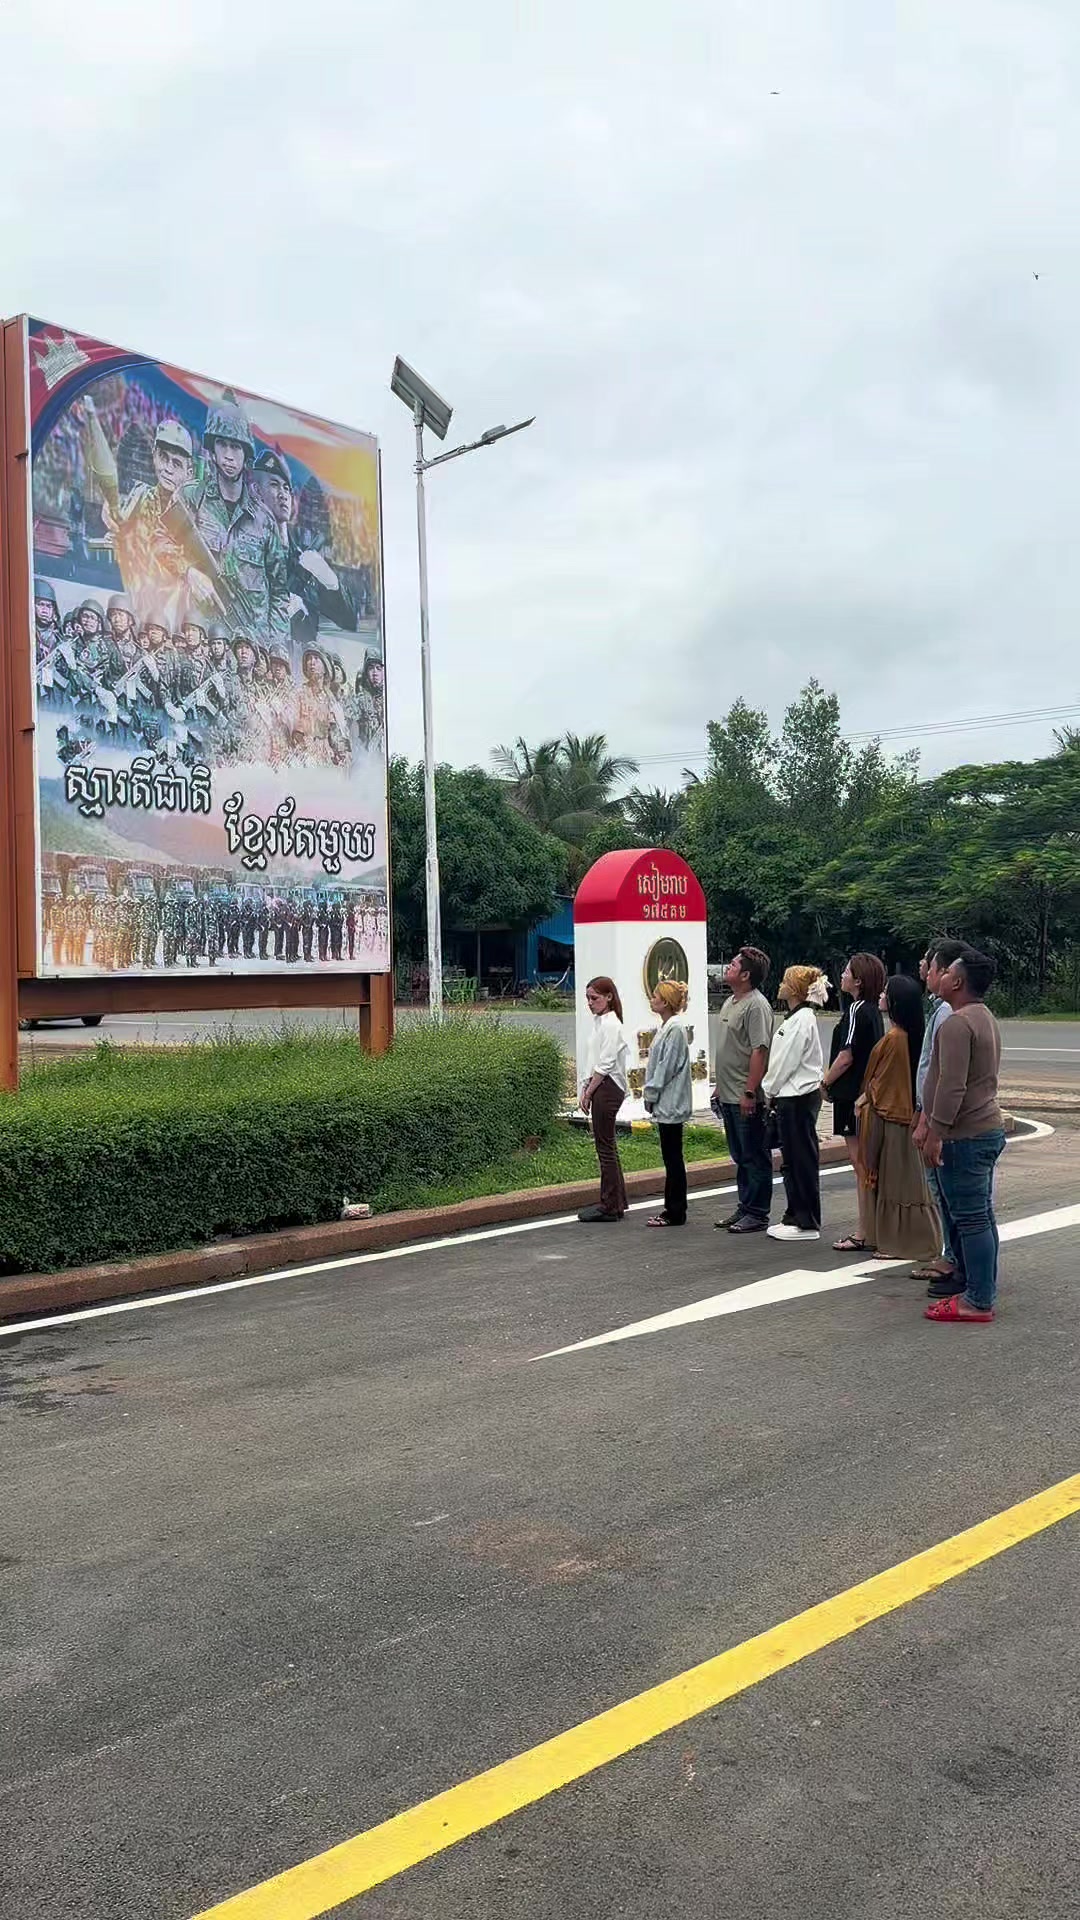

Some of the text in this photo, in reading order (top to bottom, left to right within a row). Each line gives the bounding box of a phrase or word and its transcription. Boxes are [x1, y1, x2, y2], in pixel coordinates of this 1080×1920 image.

[65, 757, 211, 818] ស្មារតីជាតិ
[224, 792, 375, 873] ខ្មែរតែមួយ
[637, 862, 688, 901] សៀមរាប
